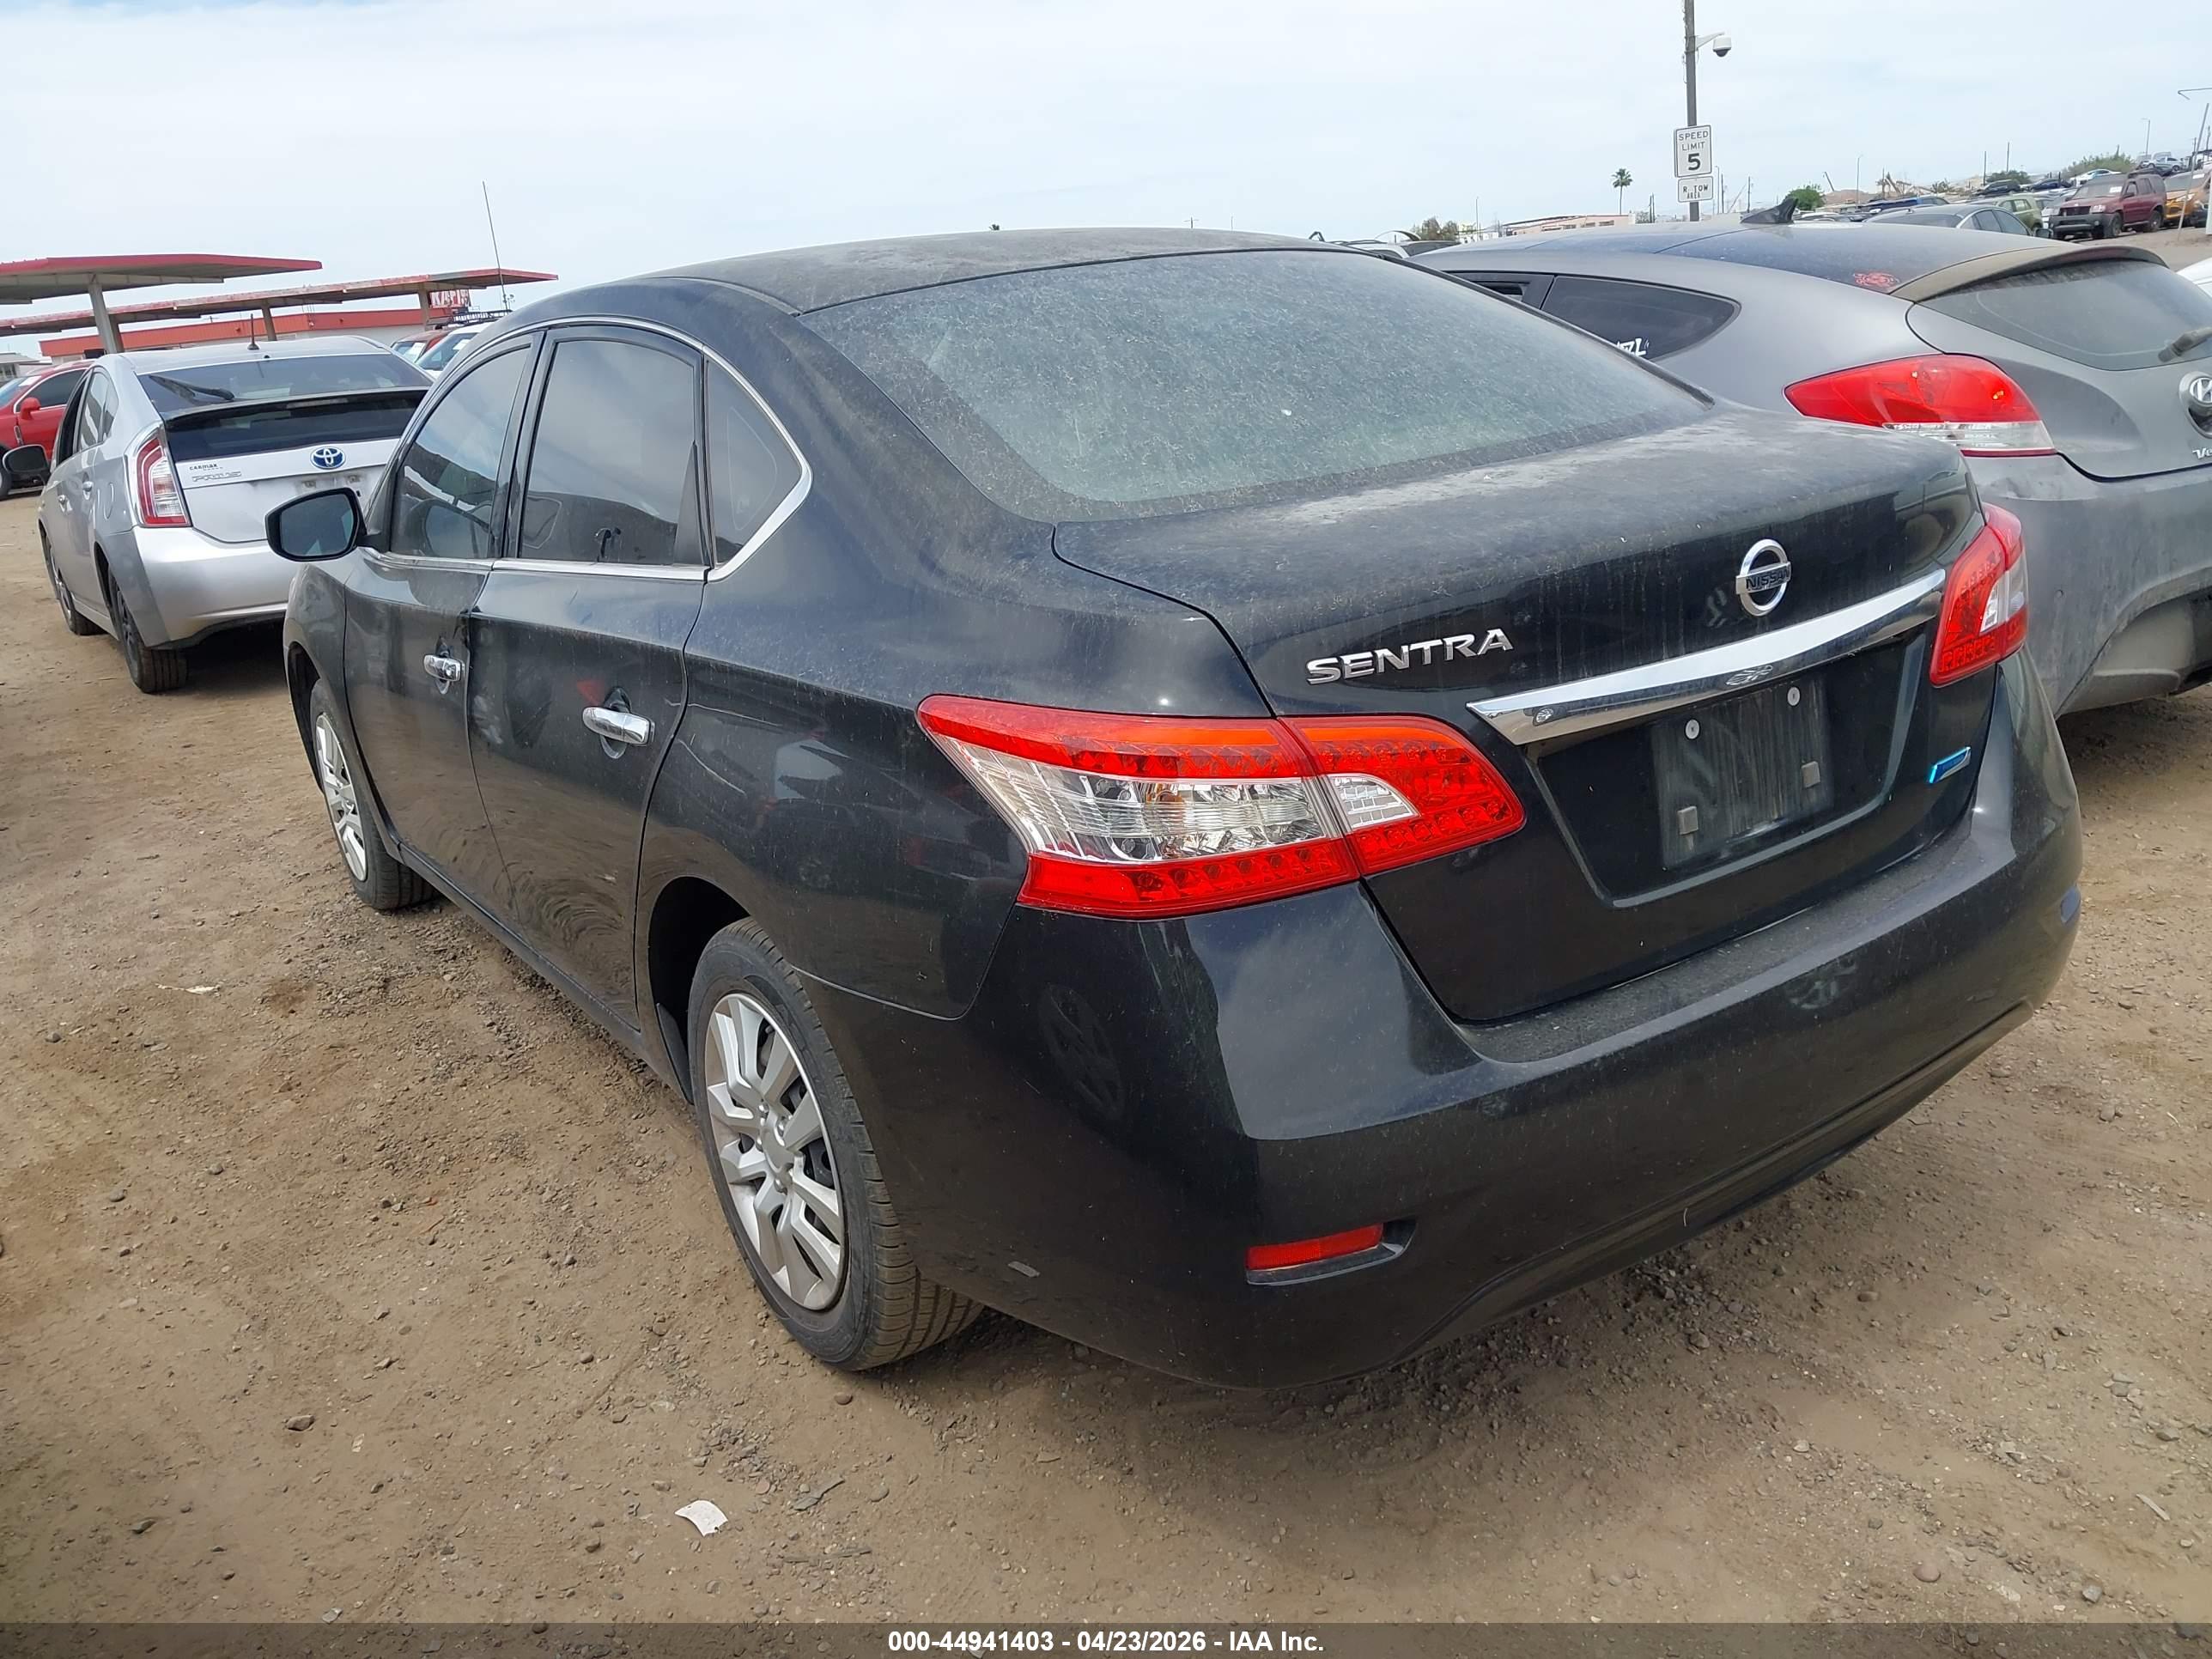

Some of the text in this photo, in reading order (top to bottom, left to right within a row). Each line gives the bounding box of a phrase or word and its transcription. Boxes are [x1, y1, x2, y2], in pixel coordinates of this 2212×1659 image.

[1678, 131, 1709, 142] SPEED
[1681, 141, 1705, 151] LIMIT
[1687, 152, 1701, 171] 5
[191, 471, 242, 482] PRIUS
[1745, 567, 1789, 591] NISSAN
[1306, 628, 1514, 685] SENTRA
